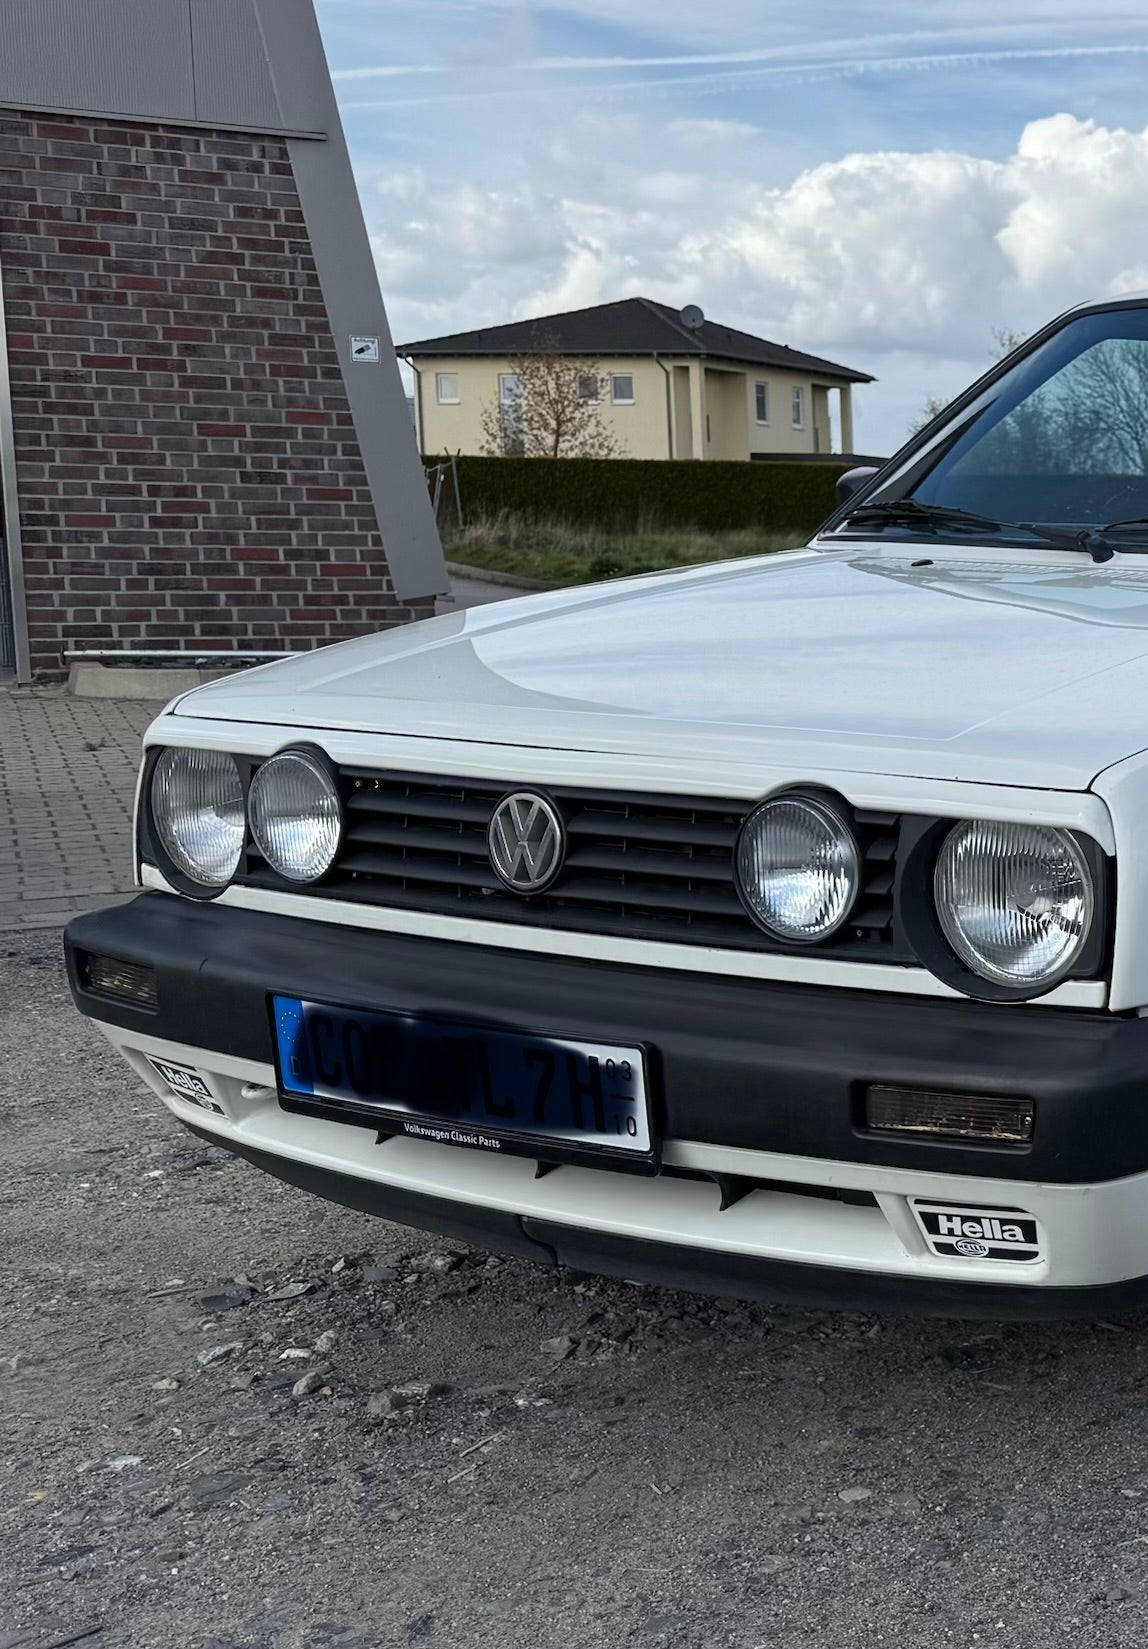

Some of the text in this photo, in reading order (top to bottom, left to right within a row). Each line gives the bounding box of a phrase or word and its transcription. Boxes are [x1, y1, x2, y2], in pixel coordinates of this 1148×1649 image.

[490, 793, 560, 888] VW
[160, 1065, 209, 1096] Hella
[403, 1122, 501, 1149] Volkswagen Classic Parts
[937, 1214, 1026, 1242] Hella
[957, 1242, 987, 1253] HELLA
